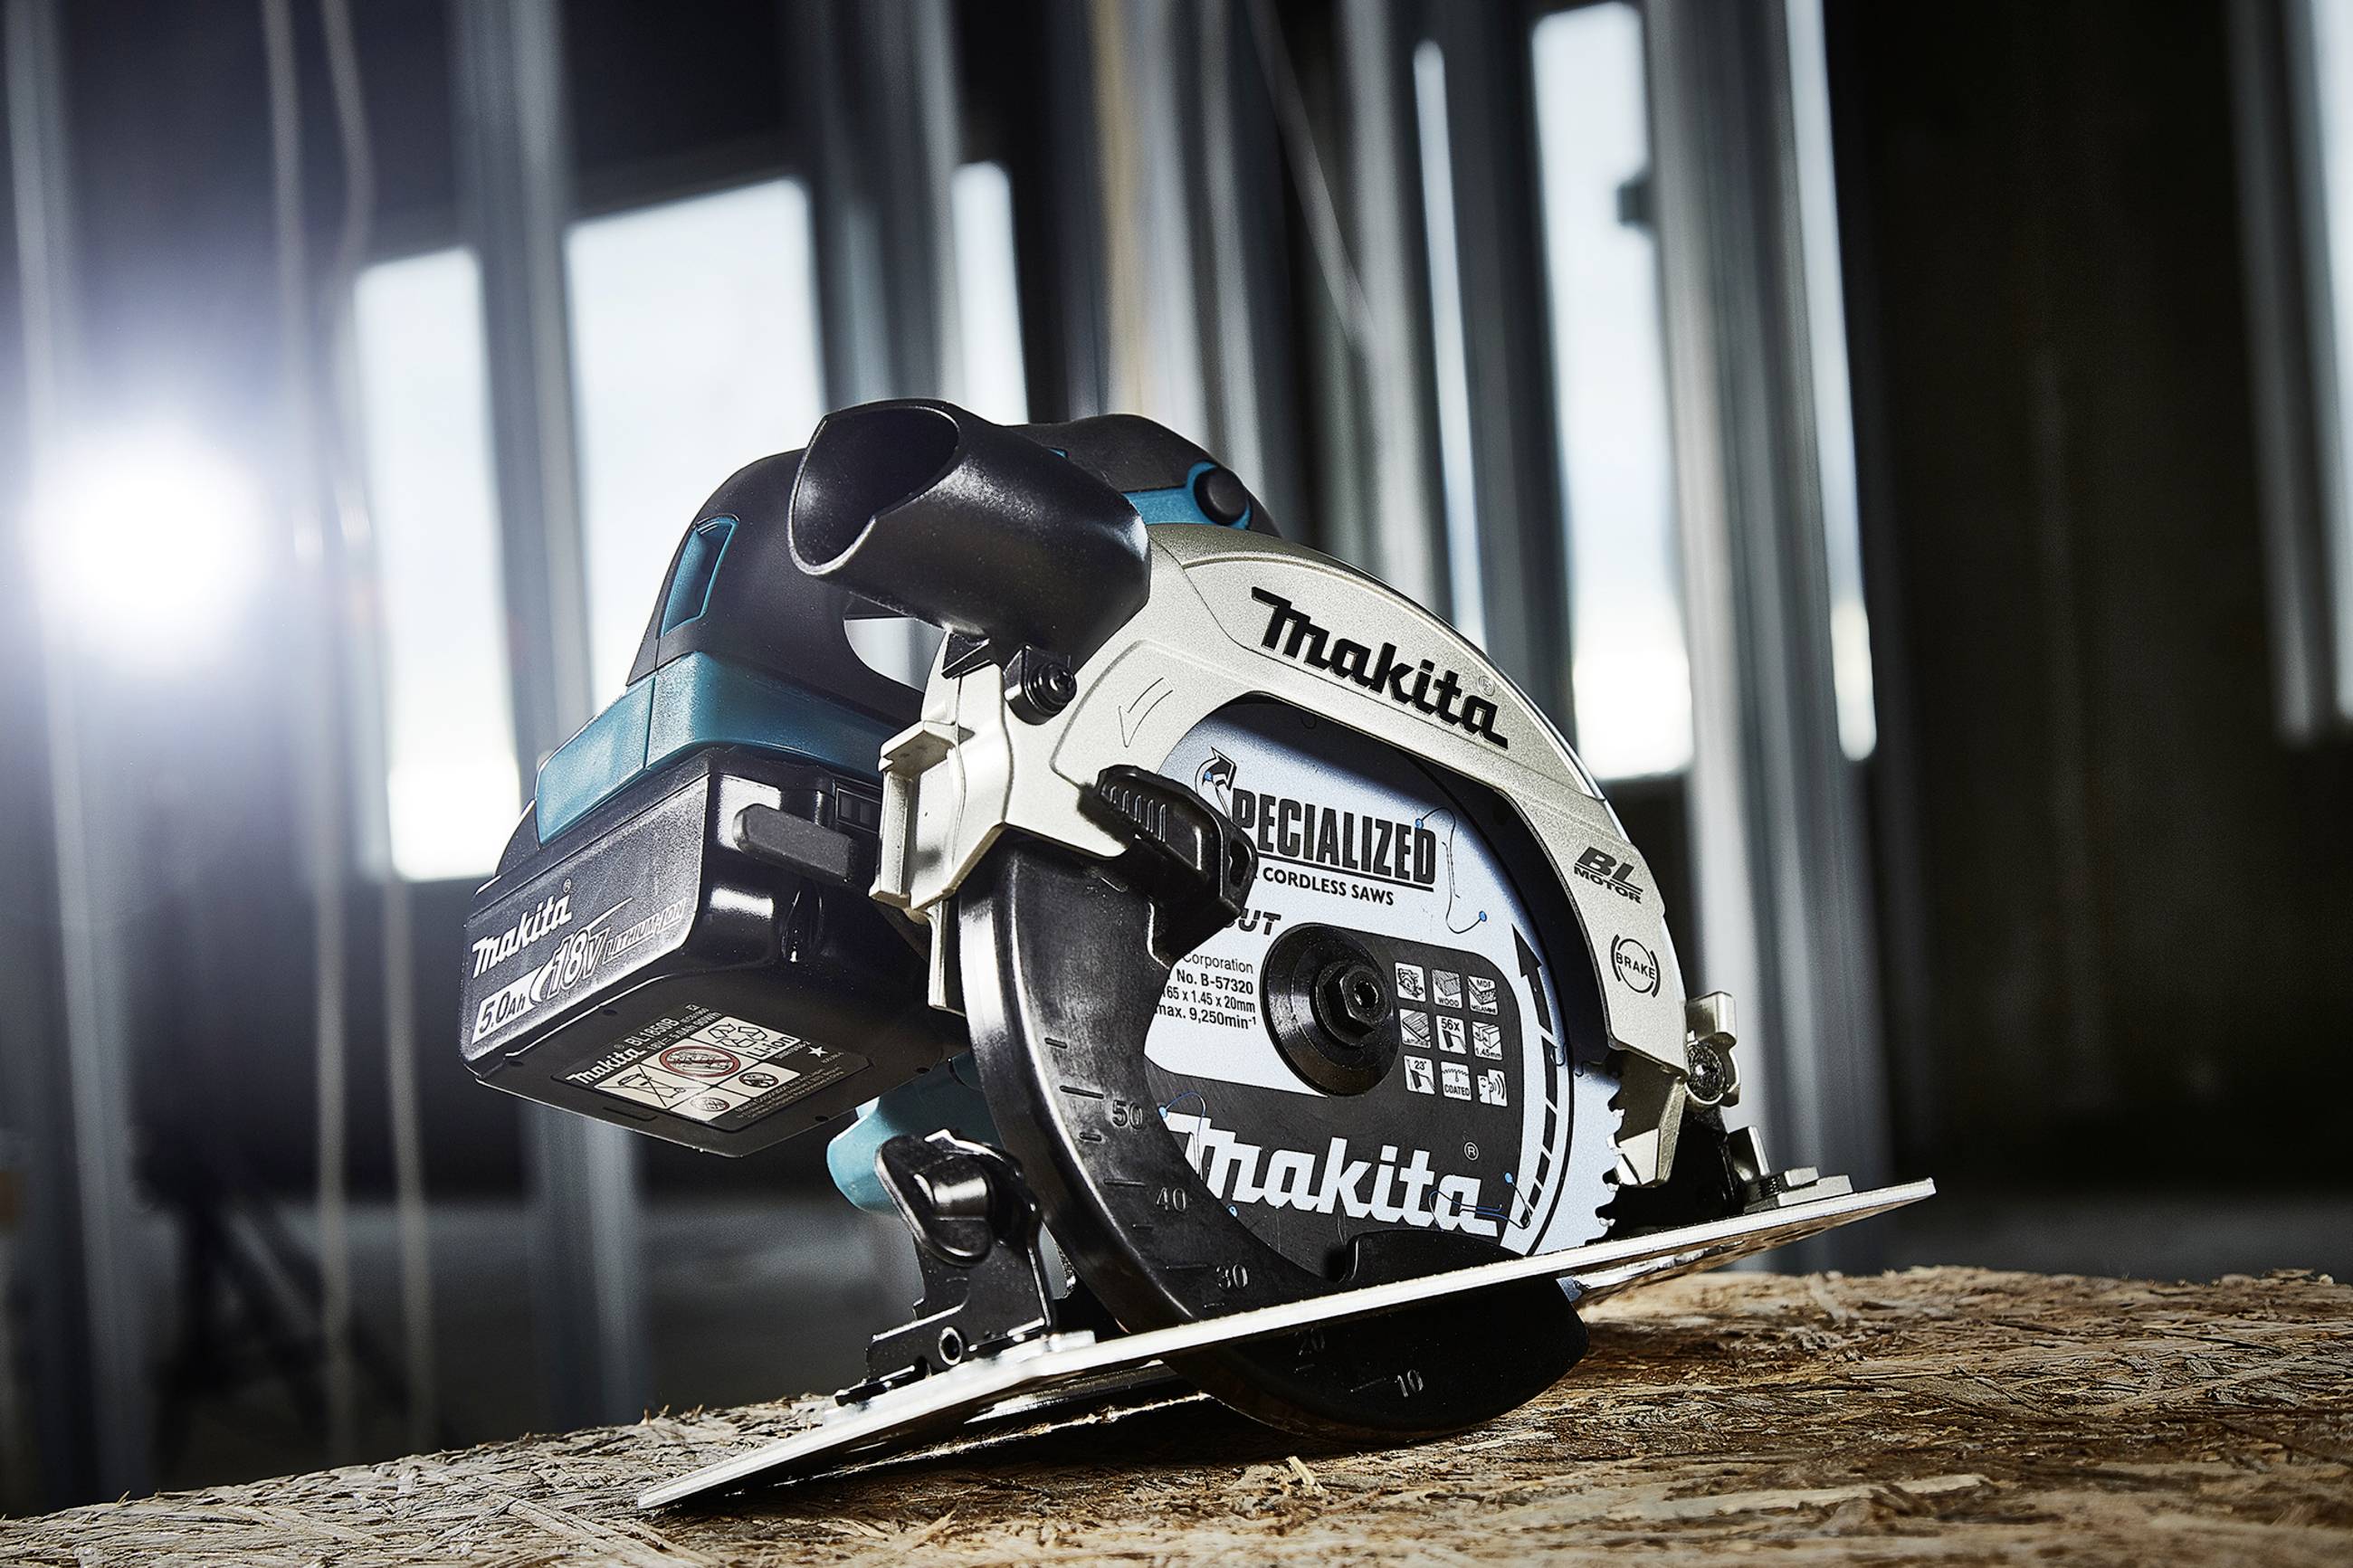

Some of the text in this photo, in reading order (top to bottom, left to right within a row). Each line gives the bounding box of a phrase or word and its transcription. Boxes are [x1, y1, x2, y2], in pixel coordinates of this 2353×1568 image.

[1232, 788, 1436, 885] PECIALIZED
[1577, 847, 1634, 883] BL
[1262, 867, 1395, 906] CORDLESS SAWS
[1574, 866, 1643, 904] MOTOR
[479, 898, 686, 1034] 5.0Ah 18V LITHIUM-ION
[1616, 952, 1655, 980] BRAKE
[1176, 969, 1253, 995] No. B-57320
[1476, 979, 1491, 989] MDF
[1157, 1004, 1186, 1019] max.
[1192, 990, 1213, 1005] 1.45
[1224, 996, 1255, 1013] 20mm
[1438, 997, 1459, 1007] WOOD
[625, 1017, 680, 1047] BL1850B
[747, 1036, 795, 1058] Li-ion
[1475, 1048, 1501, 1059] 1.45mm
[1444, 1084, 1471, 1098] COATED
[1112, 1099, 1143, 1129] 50
[1156, 1187, 1187, 1212] 40
[1216, 1263, 1249, 1289] 30
[1394, 1368, 1424, 1398] 10
